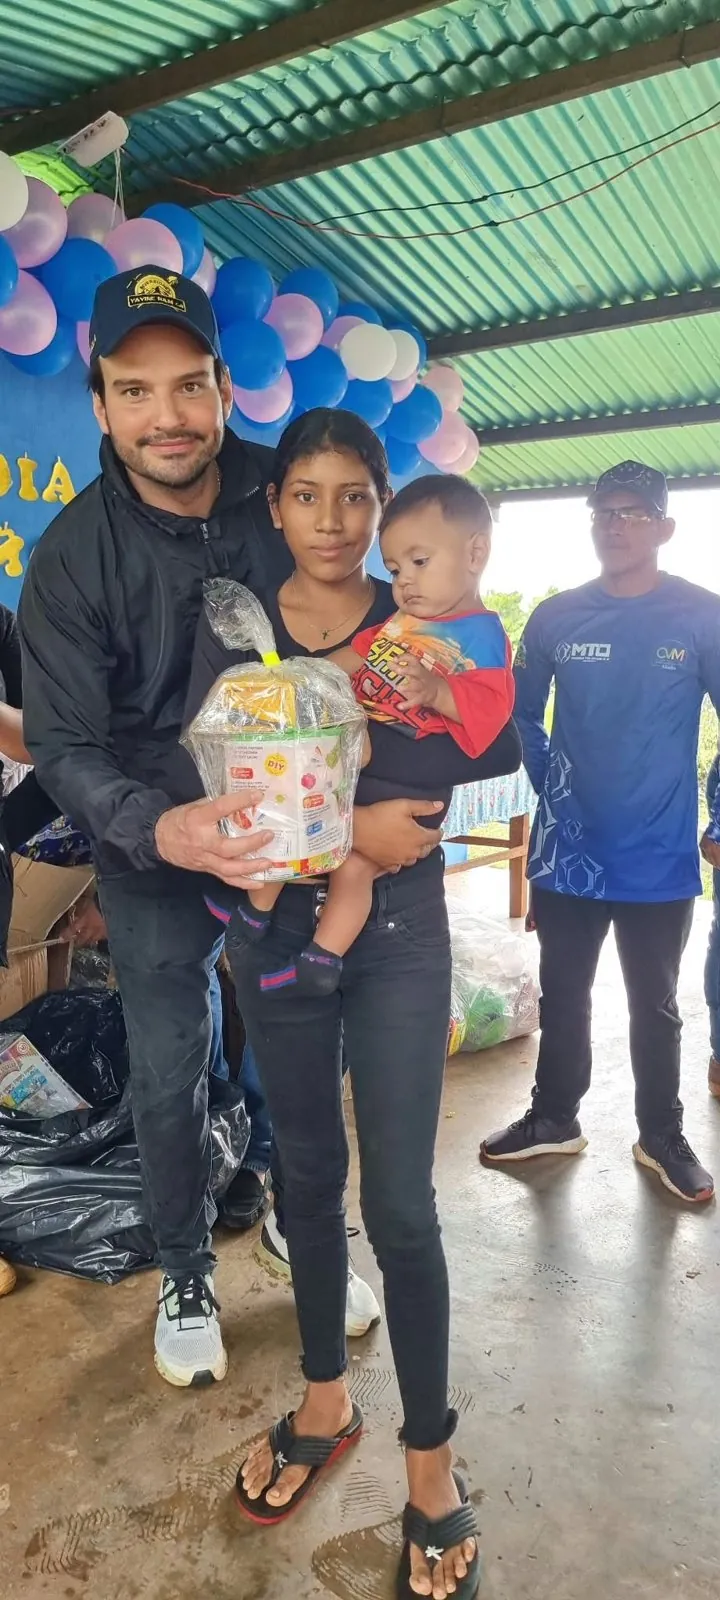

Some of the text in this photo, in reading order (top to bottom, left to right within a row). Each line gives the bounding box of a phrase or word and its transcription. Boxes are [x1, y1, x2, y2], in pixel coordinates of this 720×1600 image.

[571, 643, 611, 657] MTO
[656, 647, 685, 662] CVM
[267, 760, 285, 771] DIY
